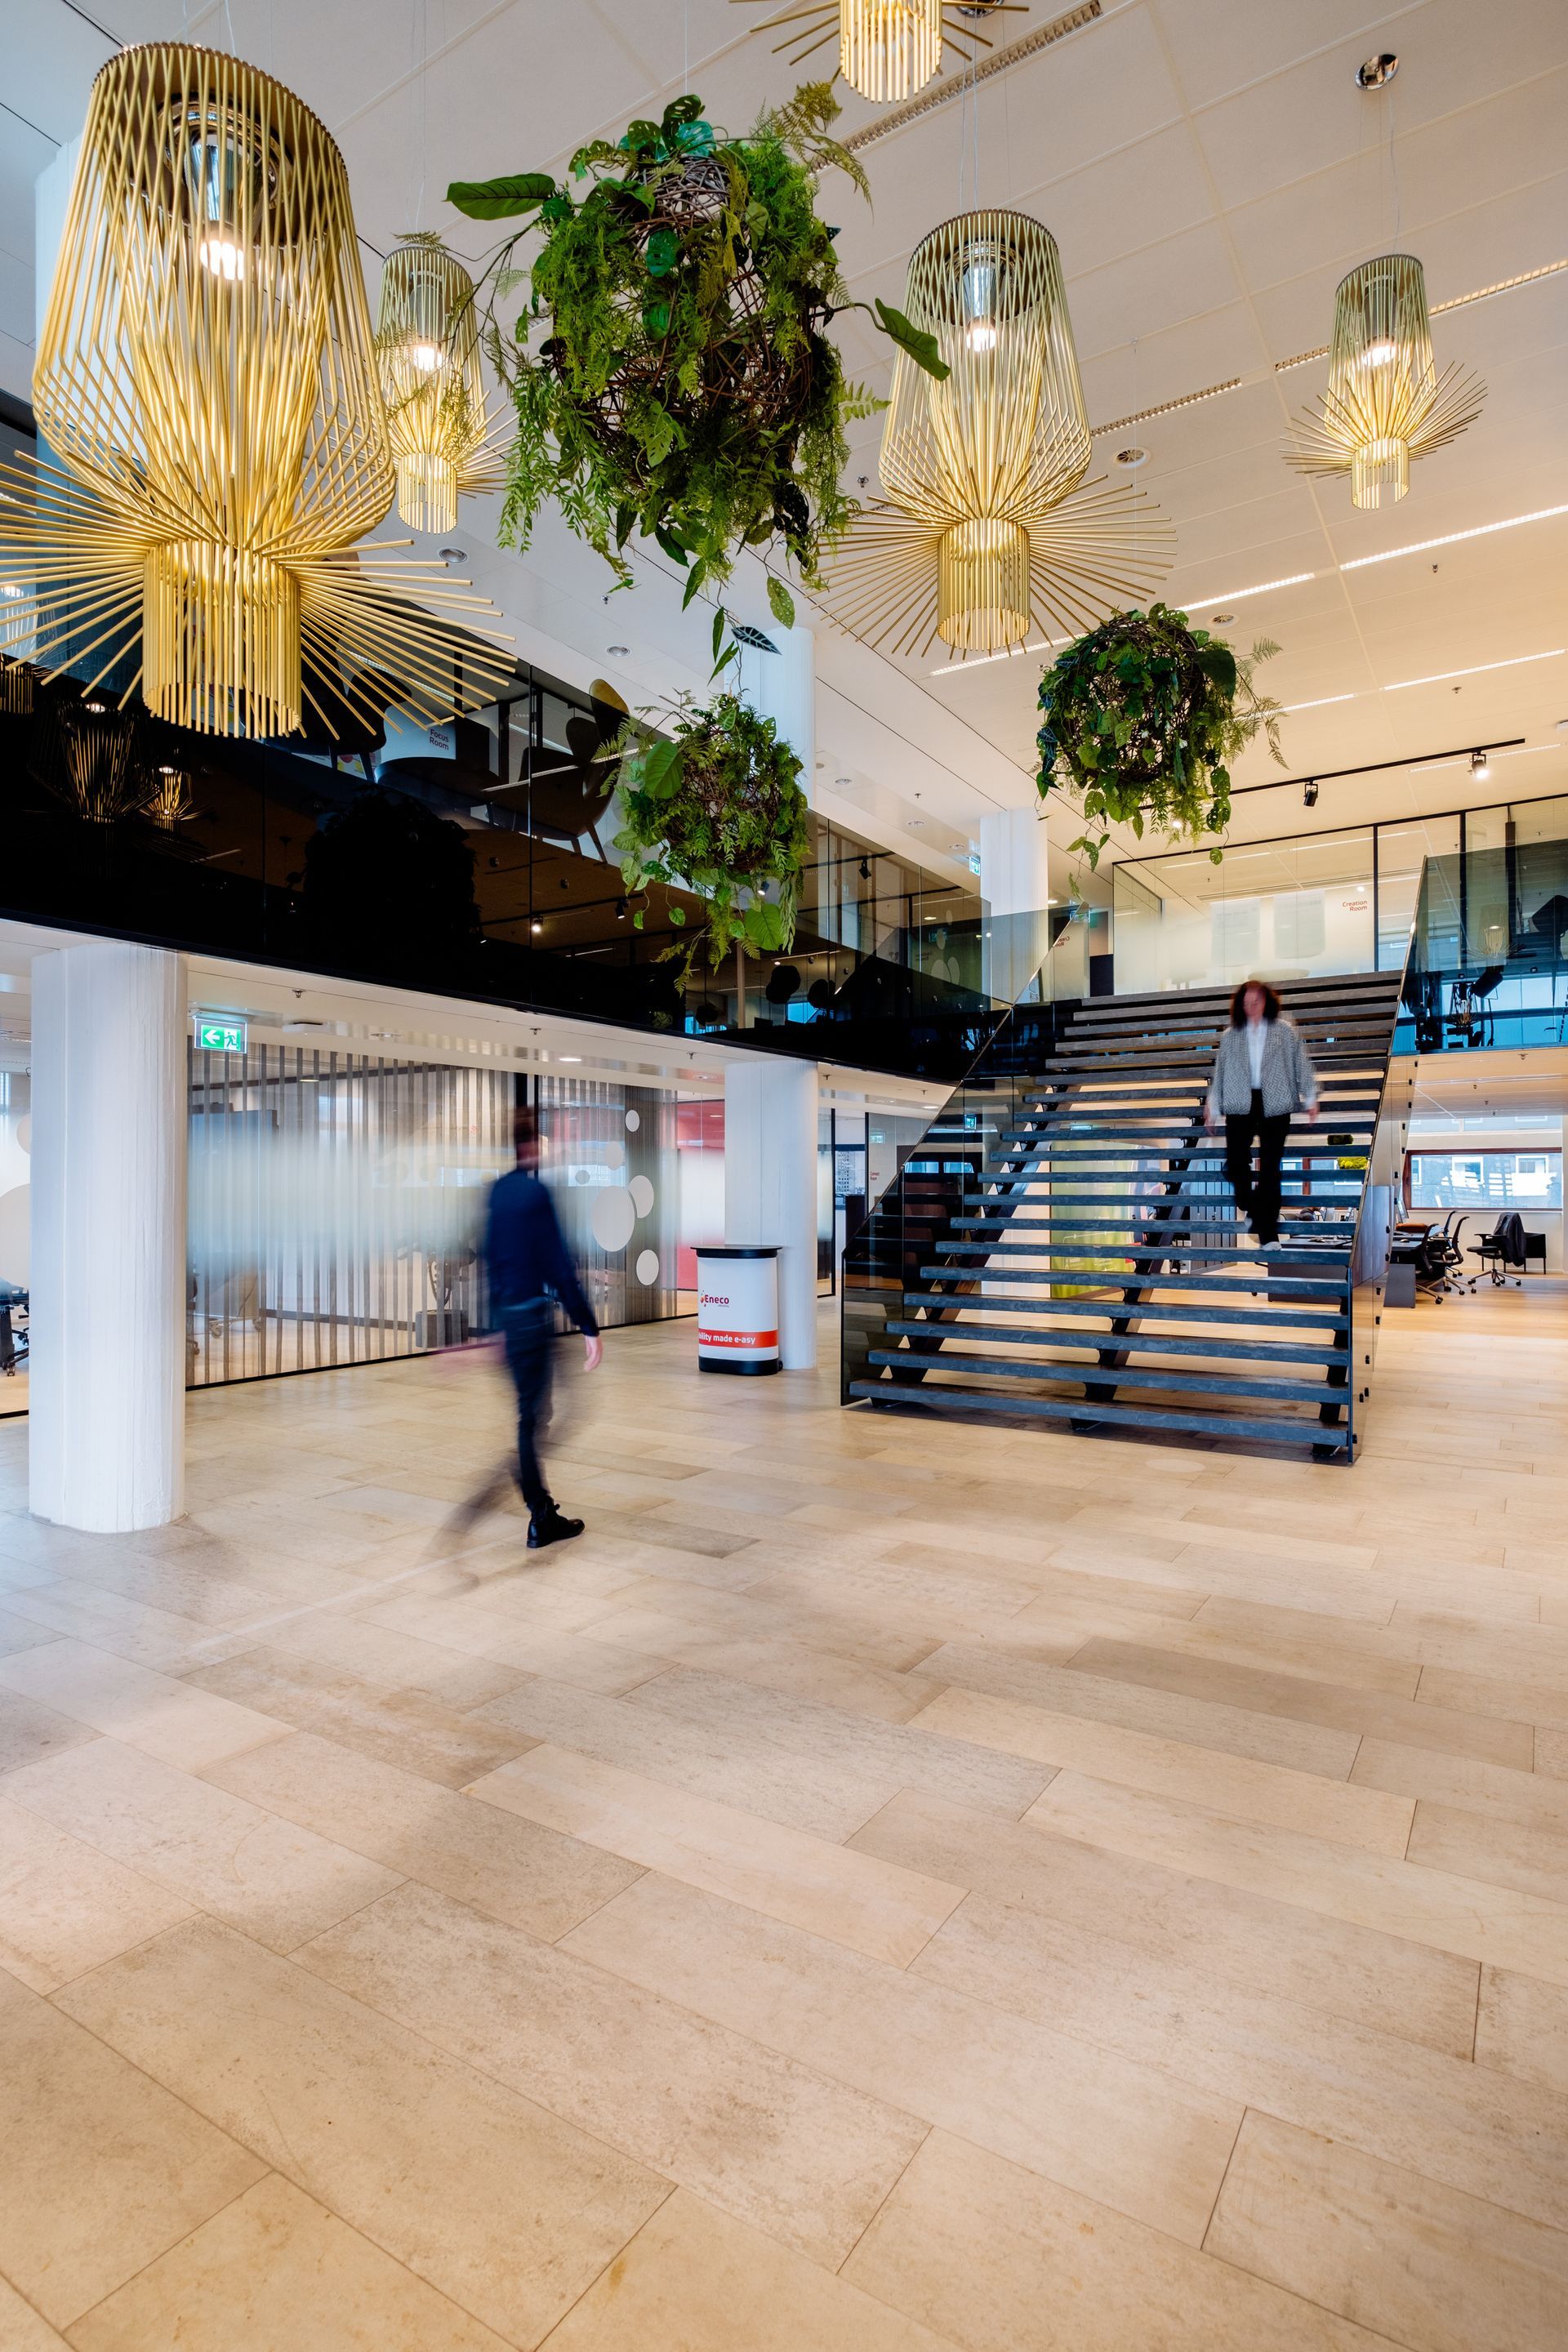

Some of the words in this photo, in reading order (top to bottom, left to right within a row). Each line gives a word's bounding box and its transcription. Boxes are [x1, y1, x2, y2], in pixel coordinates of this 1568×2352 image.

[430, 728, 449, 742] Focus
[430, 737, 449, 751] Room
[705, 1294, 729, 1304] Eneco
[713, 1334, 733, 1343] made
[734, 1336, 756, 1346] e-asy
